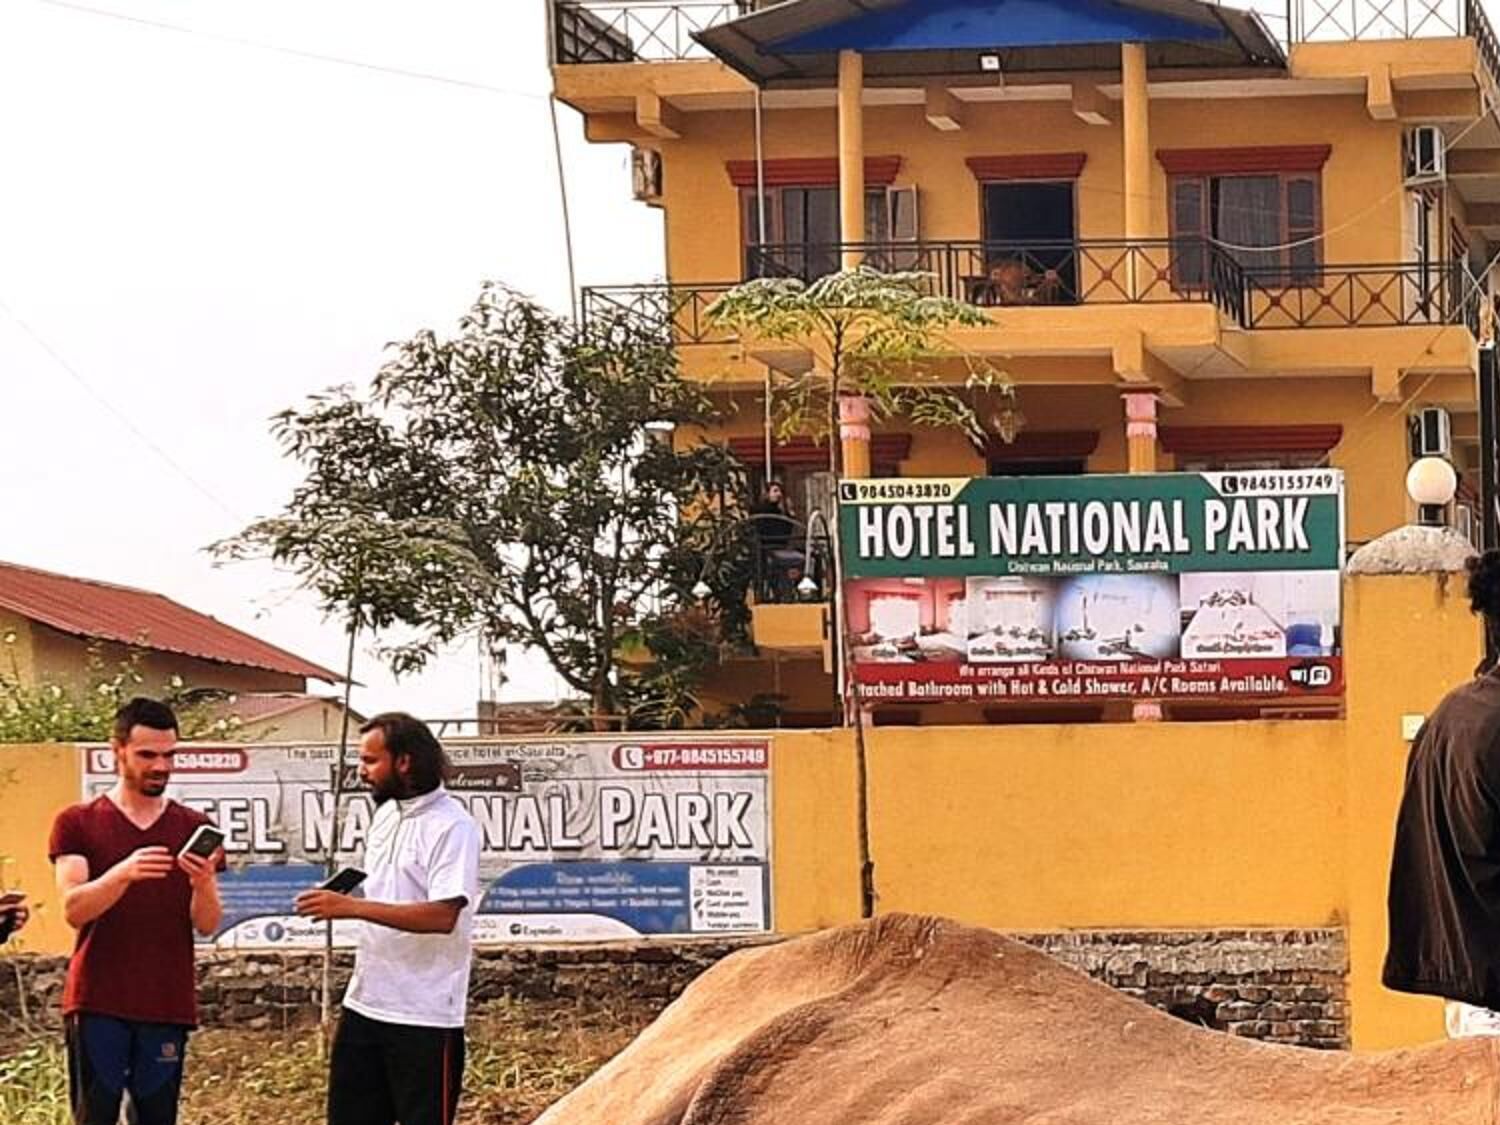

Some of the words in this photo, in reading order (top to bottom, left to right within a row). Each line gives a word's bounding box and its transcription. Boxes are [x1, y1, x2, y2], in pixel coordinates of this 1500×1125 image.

[859, 483, 951, 499] 9845043820
[1239, 475, 1333, 492] 9845155749
[859, 503, 976, 559] HOTEL
[989, 498, 1190, 557] NATIONAL
[1204, 497, 1311, 552] PARK
[1120, 661, 1161, 675] National
[907, 679, 973, 697] Bathroom
[976, 679, 1007, 696] with
[1011, 679, 1034, 696] Hot
[1037, 678, 1049, 695] &
[1052, 677, 1081, 695] Cold
[1141, 675, 1168, 696] A/C
[1171, 677, 1216, 693] Rooms
[599, 785, 753, 852] PARK
